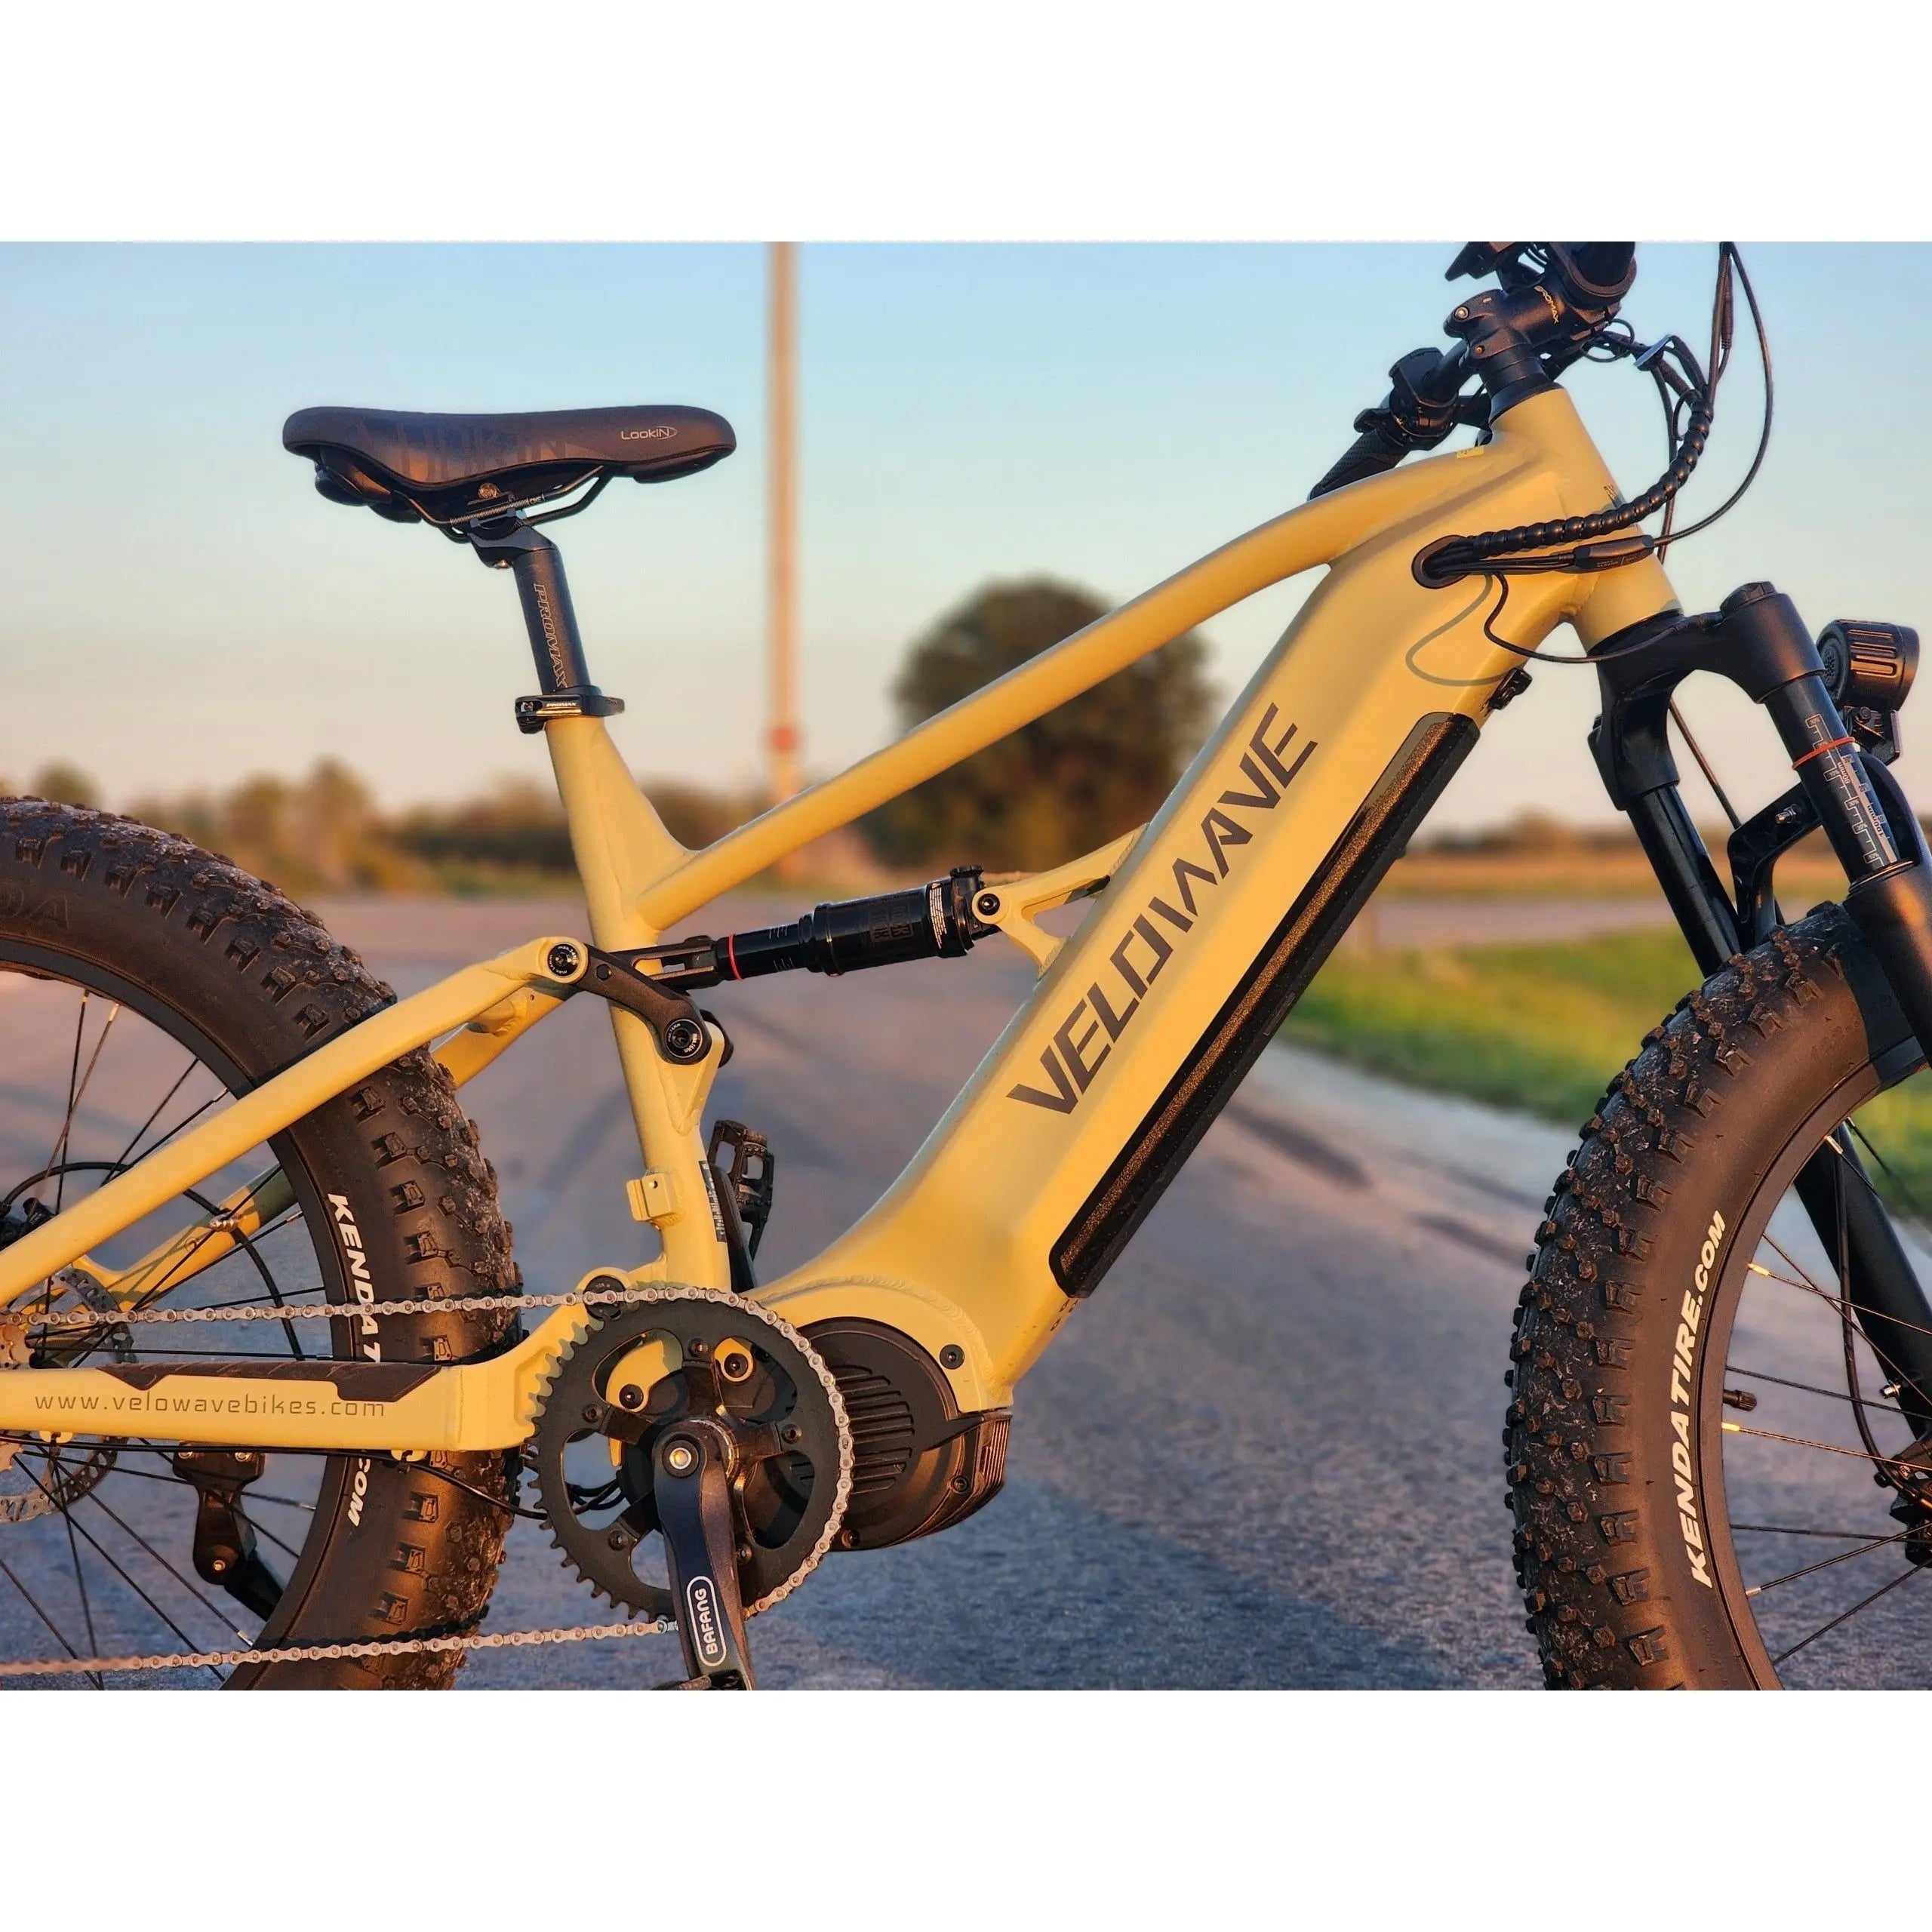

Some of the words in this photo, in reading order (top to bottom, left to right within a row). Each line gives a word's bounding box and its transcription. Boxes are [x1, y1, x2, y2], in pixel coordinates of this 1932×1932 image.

[534, 583, 568, 688] PROMAX
[1007, 703, 1318, 1114] VELOWAVE
[34, 1390, 385, 1417] www.velowavebikes.com
[694, 1588, 718, 1655] BAFANG
